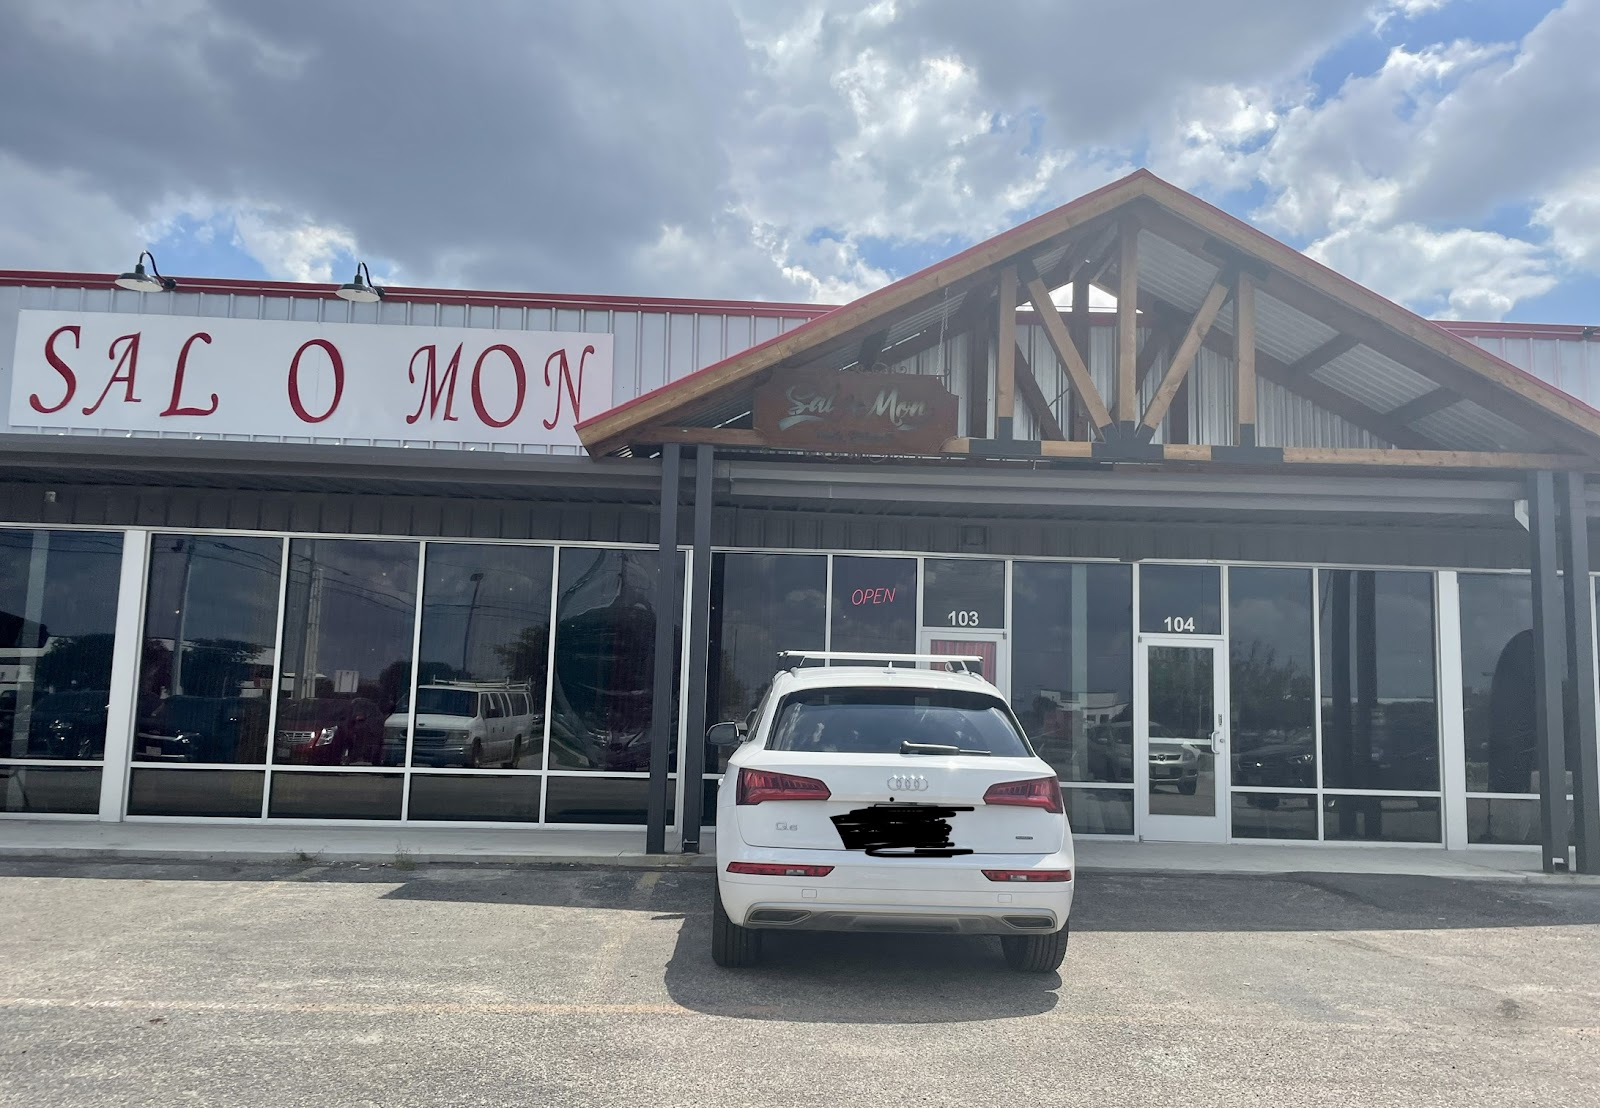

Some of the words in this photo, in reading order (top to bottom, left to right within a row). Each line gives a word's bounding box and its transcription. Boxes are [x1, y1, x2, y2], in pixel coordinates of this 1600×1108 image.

[28, 325, 219, 417] SAL
[287, 338, 345, 424] O
[405, 342, 595, 430] MON
[867, 385, 927, 426] Mon
[851, 587, 896, 606] OPEN
[947, 610, 979, 627] 103
[1163, 616, 1195, 633] 104
